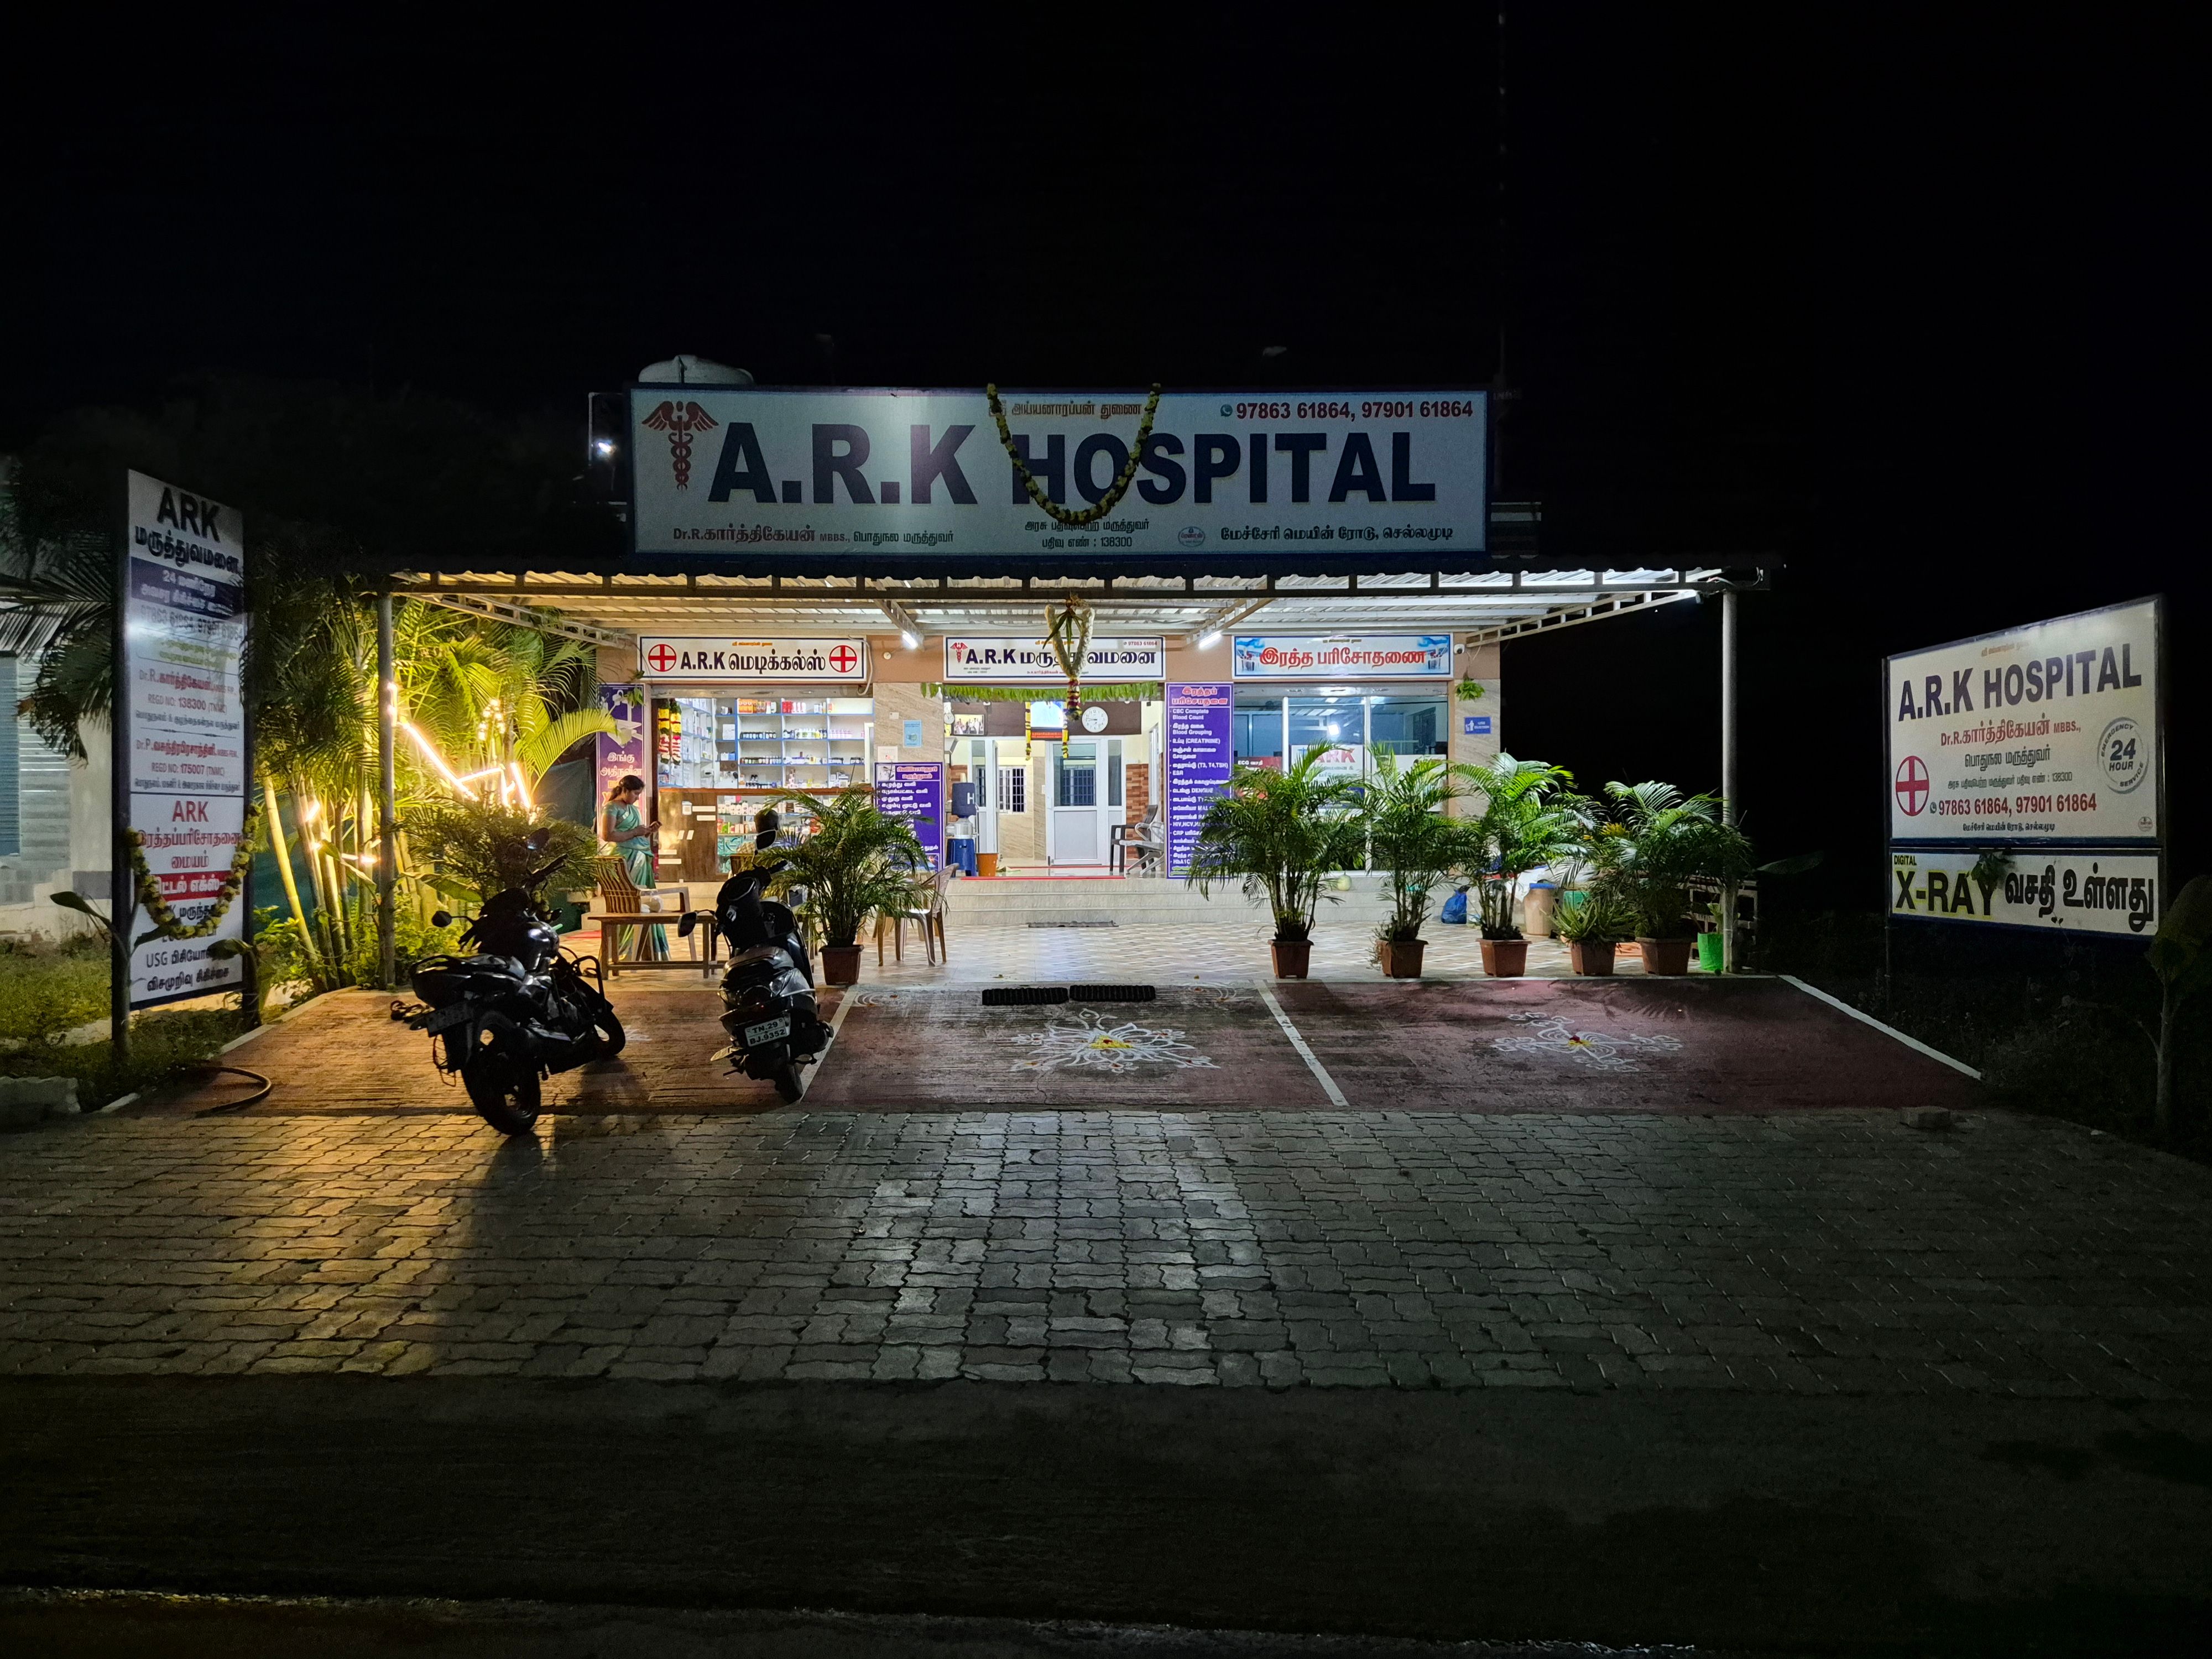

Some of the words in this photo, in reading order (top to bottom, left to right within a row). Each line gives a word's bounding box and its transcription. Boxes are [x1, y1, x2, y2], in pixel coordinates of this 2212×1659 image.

[1100, 404, 1142, 419] துணை
[1237, 402, 1291, 419] 97863
[1297, 401, 1355, 421] 61864,
[1361, 401, 1413, 418] 97901
[1420, 400, 1473, 418] 61864
[708, 422, 978, 504] A.R.K
[1011, 432, 1436, 504] HOSPITAL
[157, 487, 221, 543] ARK
[1025, 521, 1048, 532] அரசு
[1103, 518, 1149, 534] மருத்துவர்
[1220, 525, 1280, 541] மேச்சேரி
[1284, 524, 1334, 541] மெயின்
[1338, 526, 1380, 541] ரோடு,
[1383, 523, 1453, 541] செல்லமுடி
[853, 531, 899, 546] பொதுநல
[903, 530, 953, 546] மருத்துவர்
[1042, 537, 1065, 549] பதிவு
[1068, 535, 1089, 547] எண்
[1100, 536, 1133, 547] 138300
[135, 525, 240, 574] மருத்துவமனை
[162, 569, 176, 584] 24
[680, 651, 726, 670] A.R.K
[729, 648, 826, 674] மெடிக்கல்ஸ்
[966, 649, 1016, 664] A.R.K
[1259, 646, 1314, 670] இரத்த
[1898, 667, 1974, 722] A.R.K
[1984, 643, 2142, 709] HOSPITAL
[1182, 686, 1218, 697] இரத்தப்
[178, 696, 206, 710] 138300
[1171, 696, 1228, 706] பரிசோதனை
[2053, 721, 2081, 734] MBBS.,
[2101, 723, 2134, 757] EMERGENCY
[607, 750, 635, 763] இங்கு
[1965, 753, 2002, 771] பொதுநல
[2005, 744, 2051, 768] மருத்துவர்
[2110, 738, 2136, 761] 24
[180, 763, 205, 775] 175007
[2109, 761, 2133, 771] HOUR
[2052, 771, 2073, 782] 138300
[2119, 763, 2144, 787] SERVICE
[172, 800, 209, 822] ARK
[1939, 800, 1971, 816] 97863
[1975, 797, 2012, 818] 61864,
[2016, 795, 2052, 814] 97901
[2057, 792, 2097, 812] 61864
[171, 849, 210, 868] மையம்
[1893, 855, 1917, 866] DIGITAL
[1895, 870, 1997, 916] X-RAY
[2005, 864, 2056, 918] வசதி
[2063, 862, 2154, 932] உள்ளது
[146, 951, 168, 968] USG
[147, 971, 193, 992] விசமுறிவு
[752, 1021, 778, 1034] TN.29
